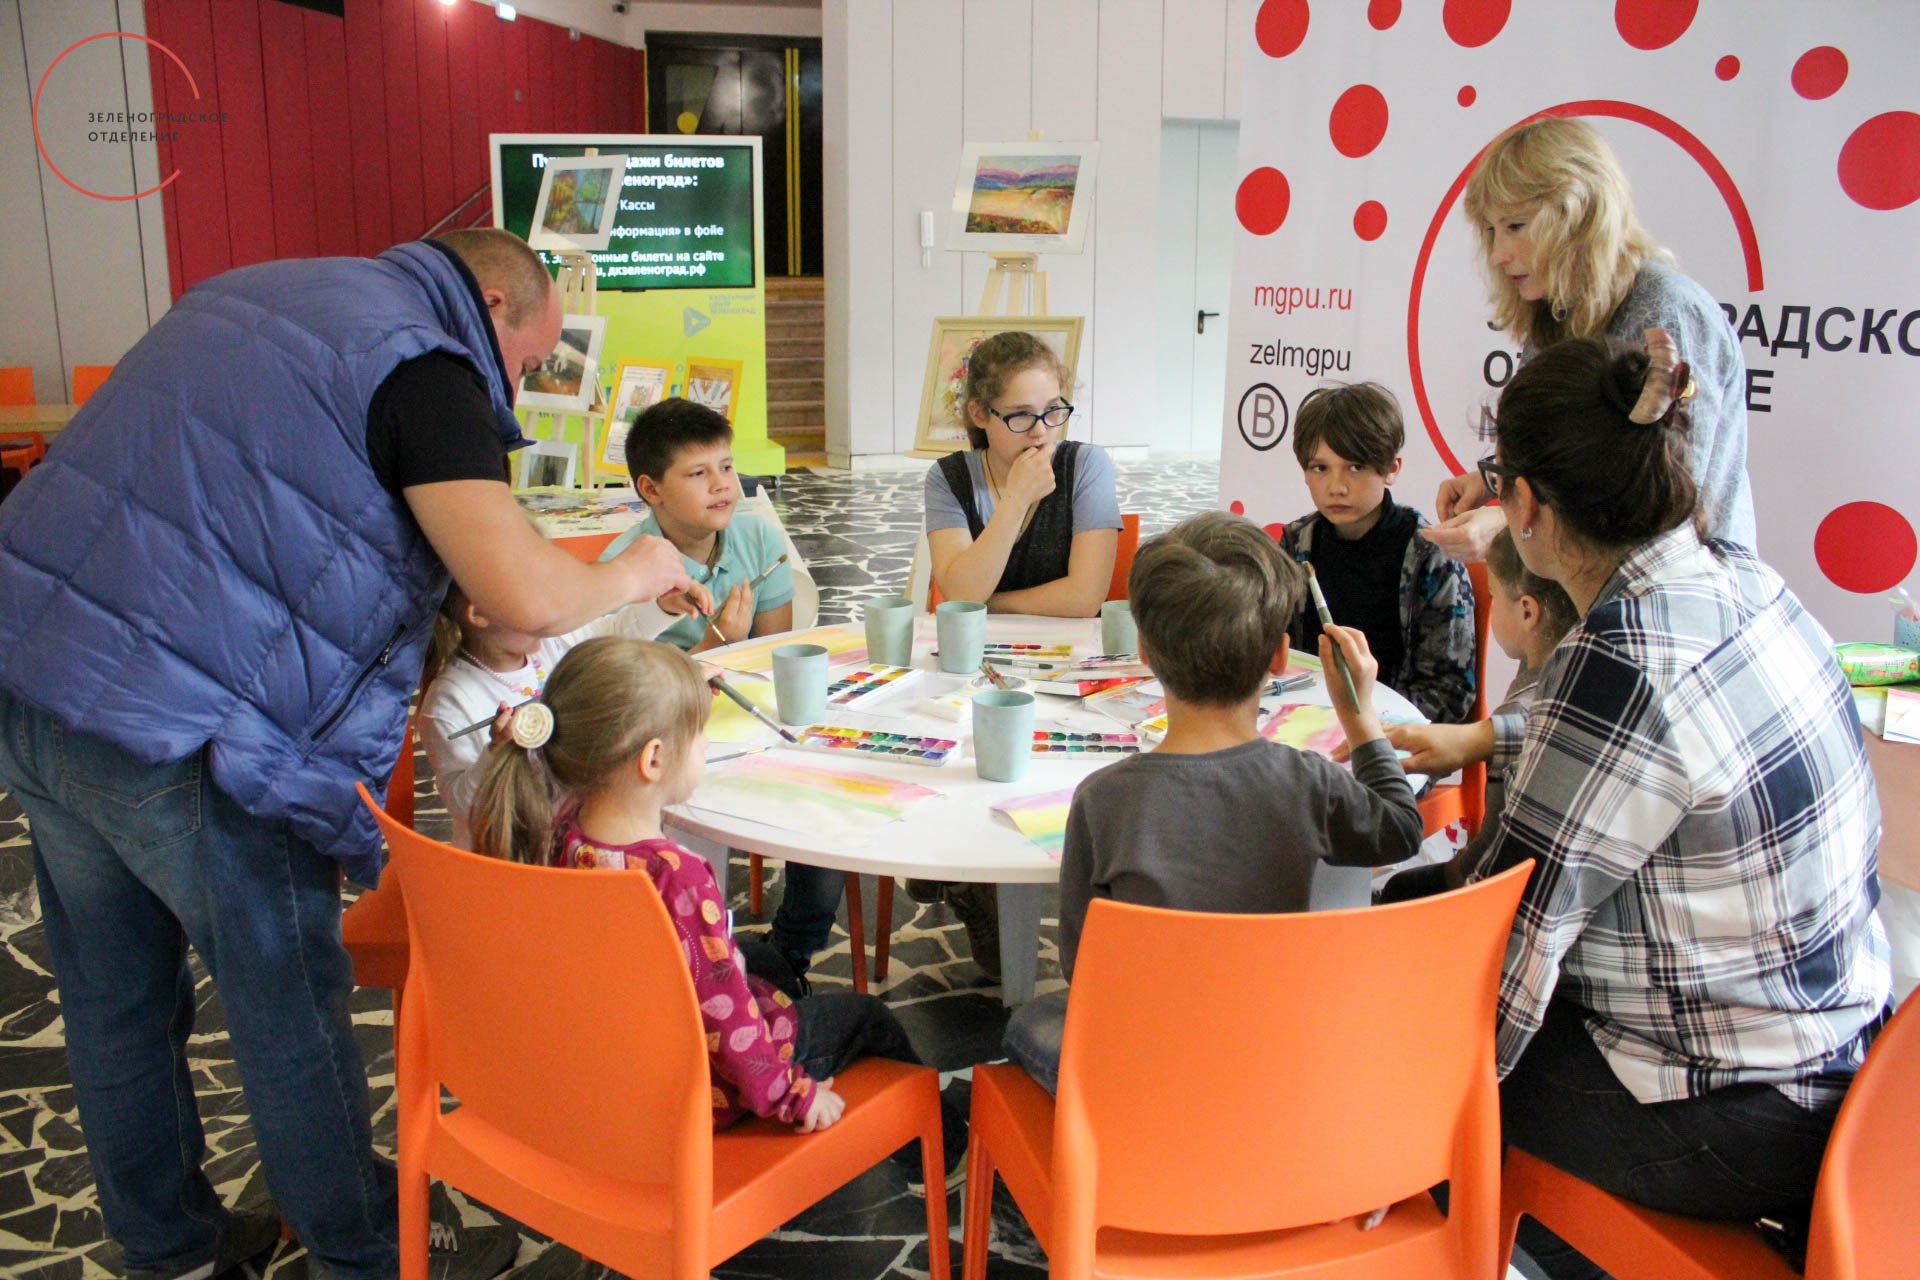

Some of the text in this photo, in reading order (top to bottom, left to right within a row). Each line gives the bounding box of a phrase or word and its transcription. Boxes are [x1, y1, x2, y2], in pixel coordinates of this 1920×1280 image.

[664, 153, 725, 168] билетов
[622, 174, 698, 189] еноград»:
[620, 199, 656, 211] Кассы
[694, 225, 724, 238] фойе
[631, 251, 673, 263] билеты
[676, 252, 690, 262] на
[693, 250, 725, 262] сайте
[1254, 285, 1352, 315] mgpu.ru
[1250, 338, 1351, 376] zelmgpu
